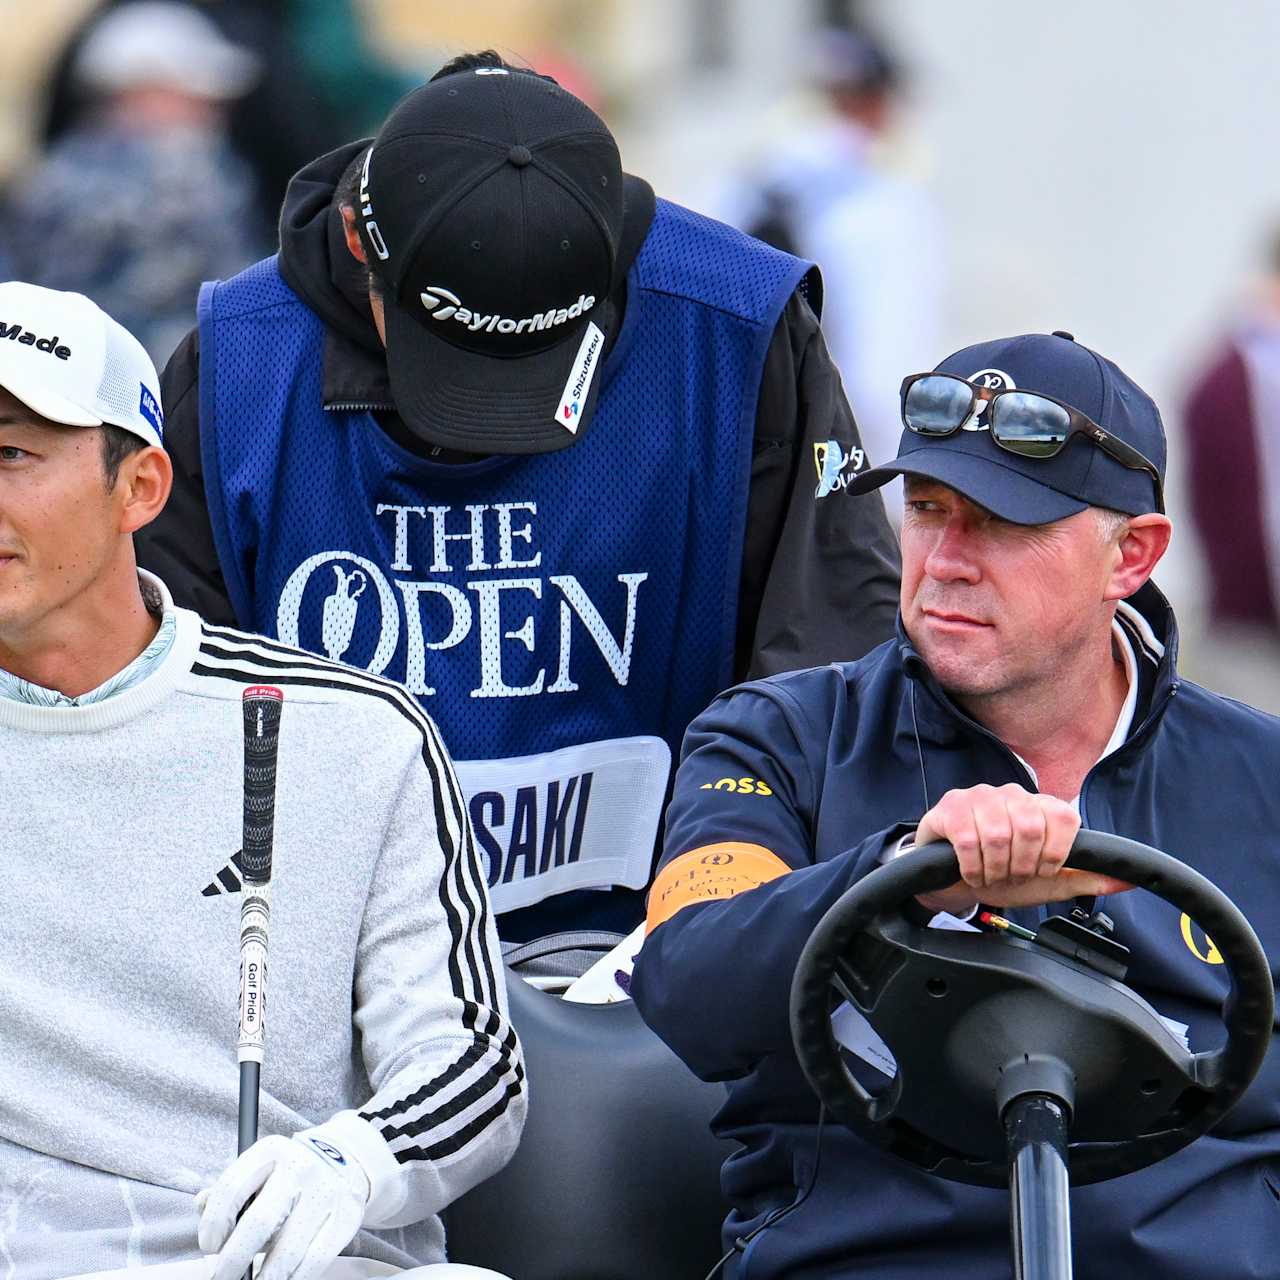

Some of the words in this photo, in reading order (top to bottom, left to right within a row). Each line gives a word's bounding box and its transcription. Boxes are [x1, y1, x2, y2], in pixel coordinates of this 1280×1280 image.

[420, 286, 596, 334] TaylorMade
[572, 333, 601, 400] Shizutetsu
[376, 501, 542, 572] THE
[276, 550, 649, 698] OPEN
[699, 777, 773, 796] OSS
[247, 962, 258, 988] Golf
[246, 991, 257, 1023] Pride
